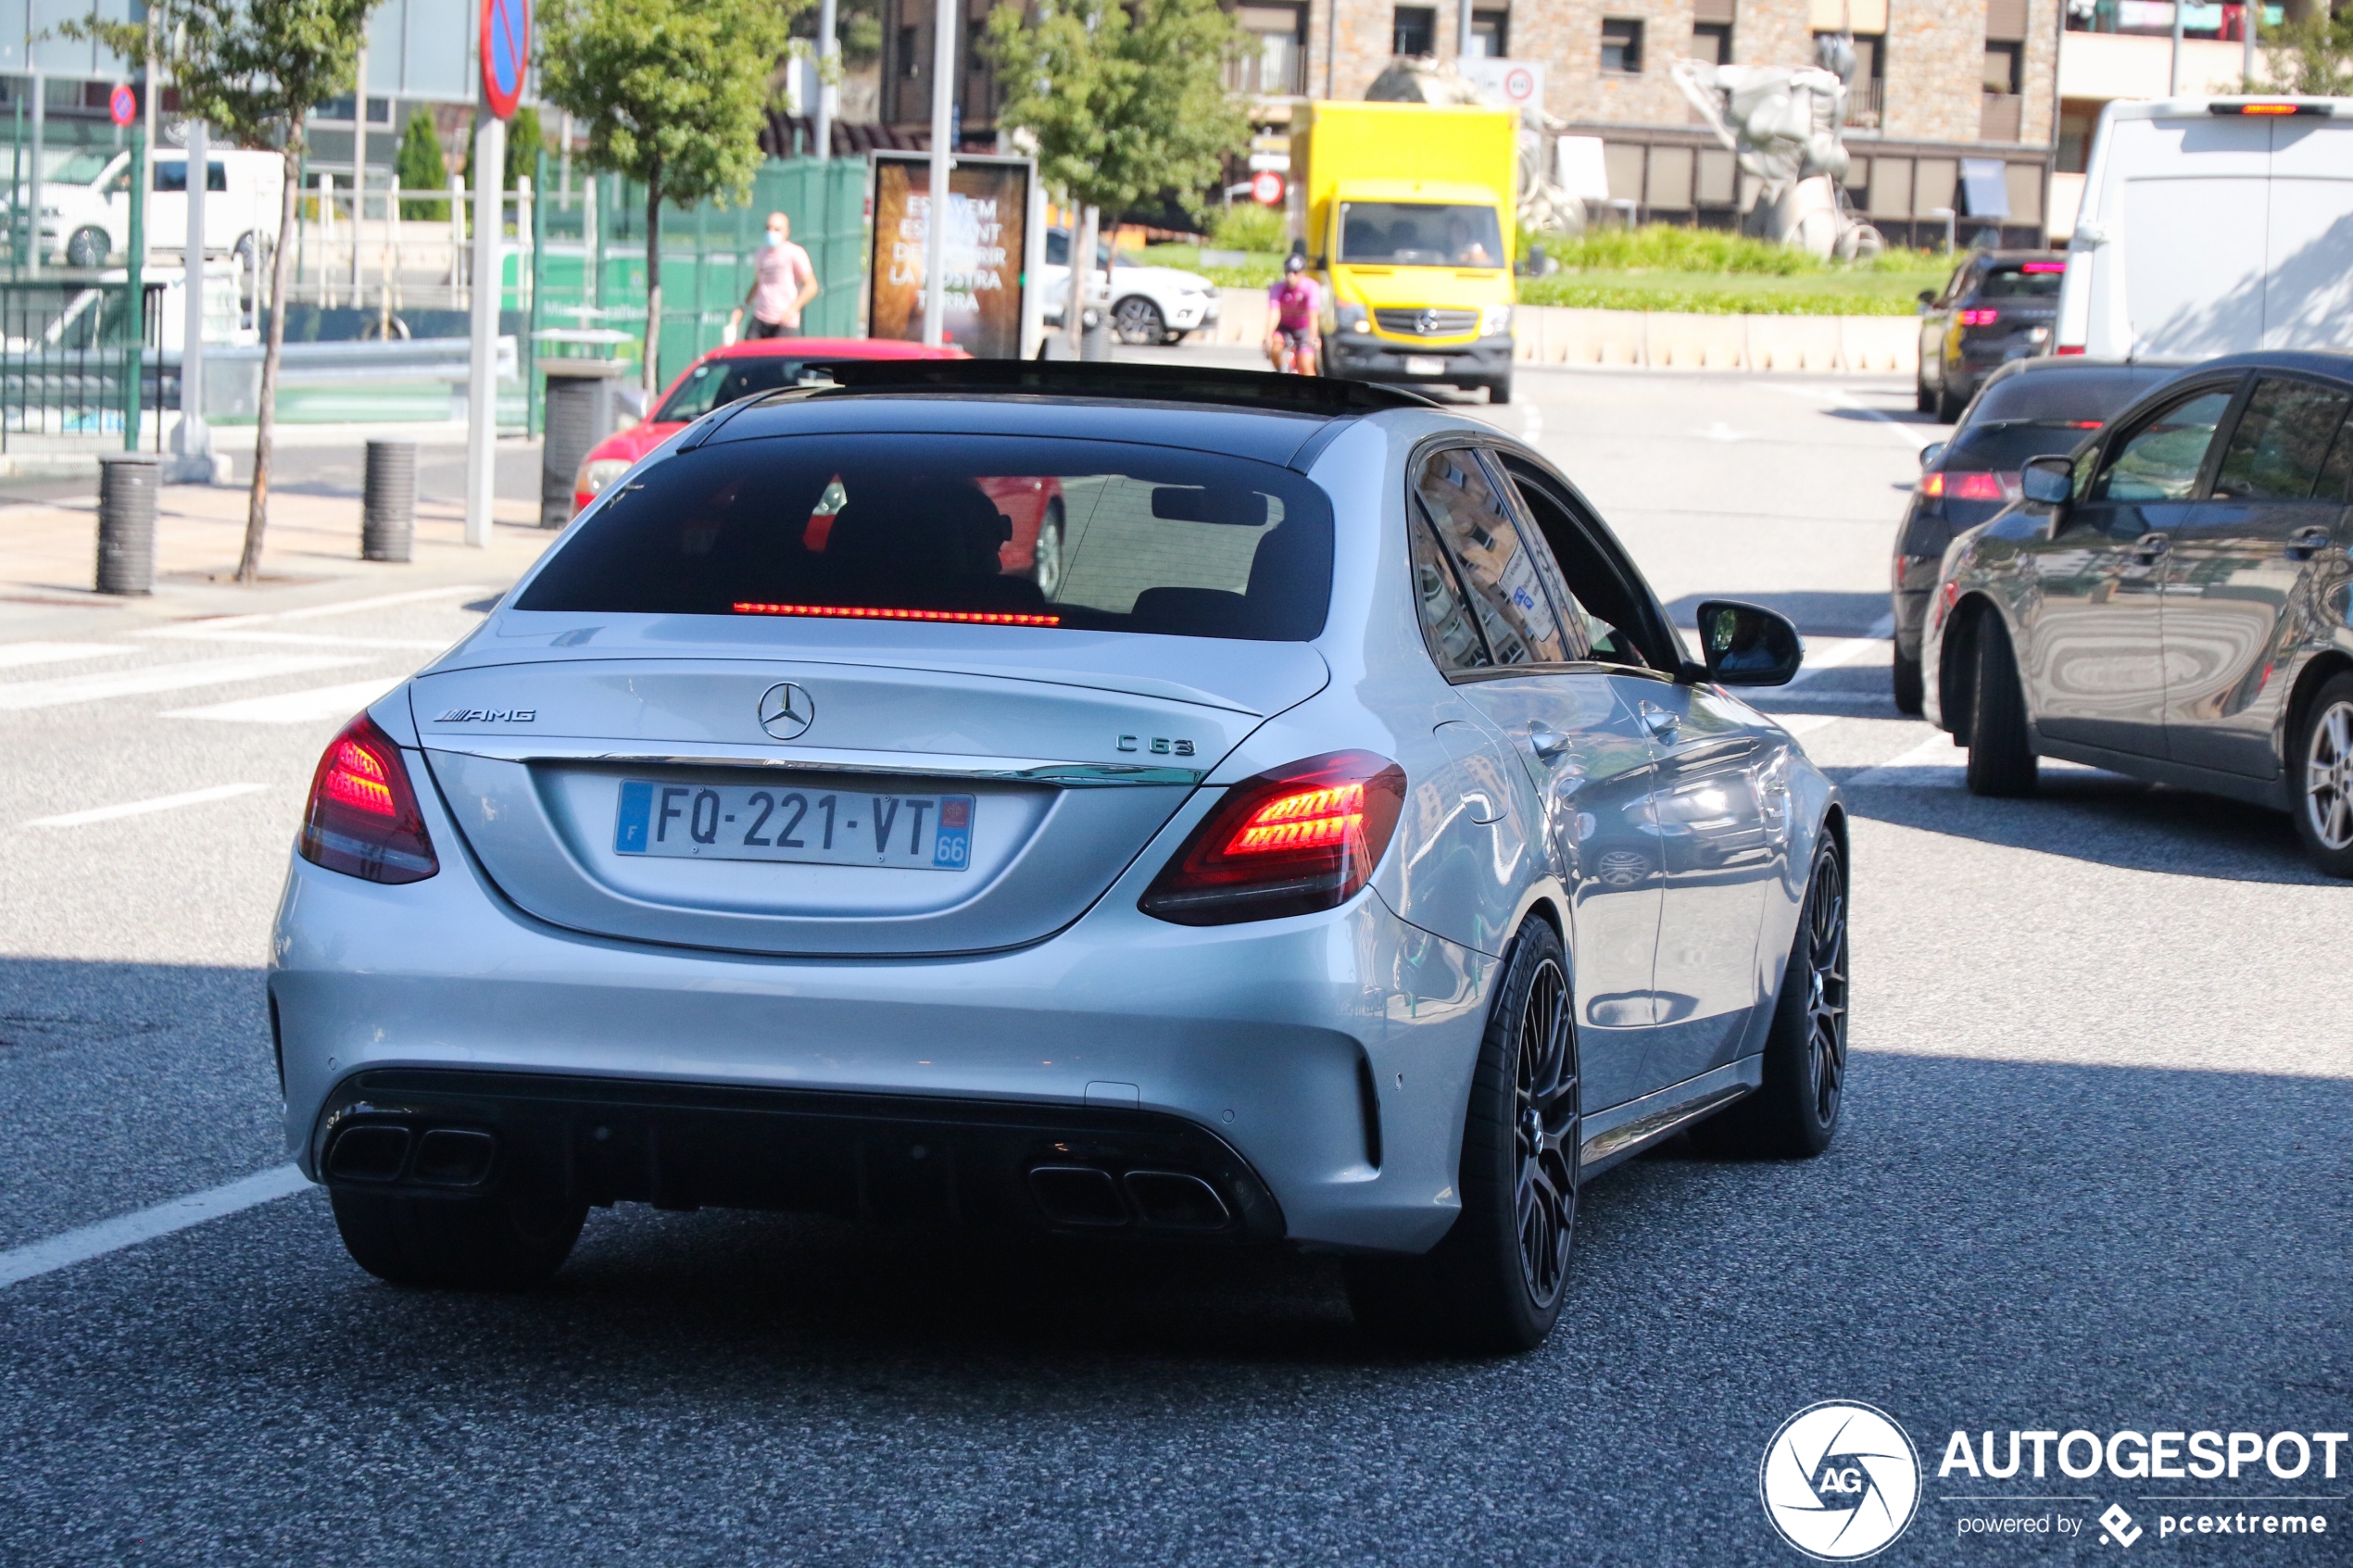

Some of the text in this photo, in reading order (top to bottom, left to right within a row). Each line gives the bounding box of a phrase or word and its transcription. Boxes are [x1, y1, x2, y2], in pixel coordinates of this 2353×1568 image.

[907, 195, 998, 220] ESAVEM
[900, 219, 1002, 243] ESANT
[889, 264, 915, 287] LA
[915, 289, 980, 311] TRRA
[461, 709, 536, 722] AMG
[1115, 734, 1197, 757] C 63
[626, 824, 638, 840] F
[656, 786, 934, 856] FQ-221-VT
[937, 835, 965, 862] 66
